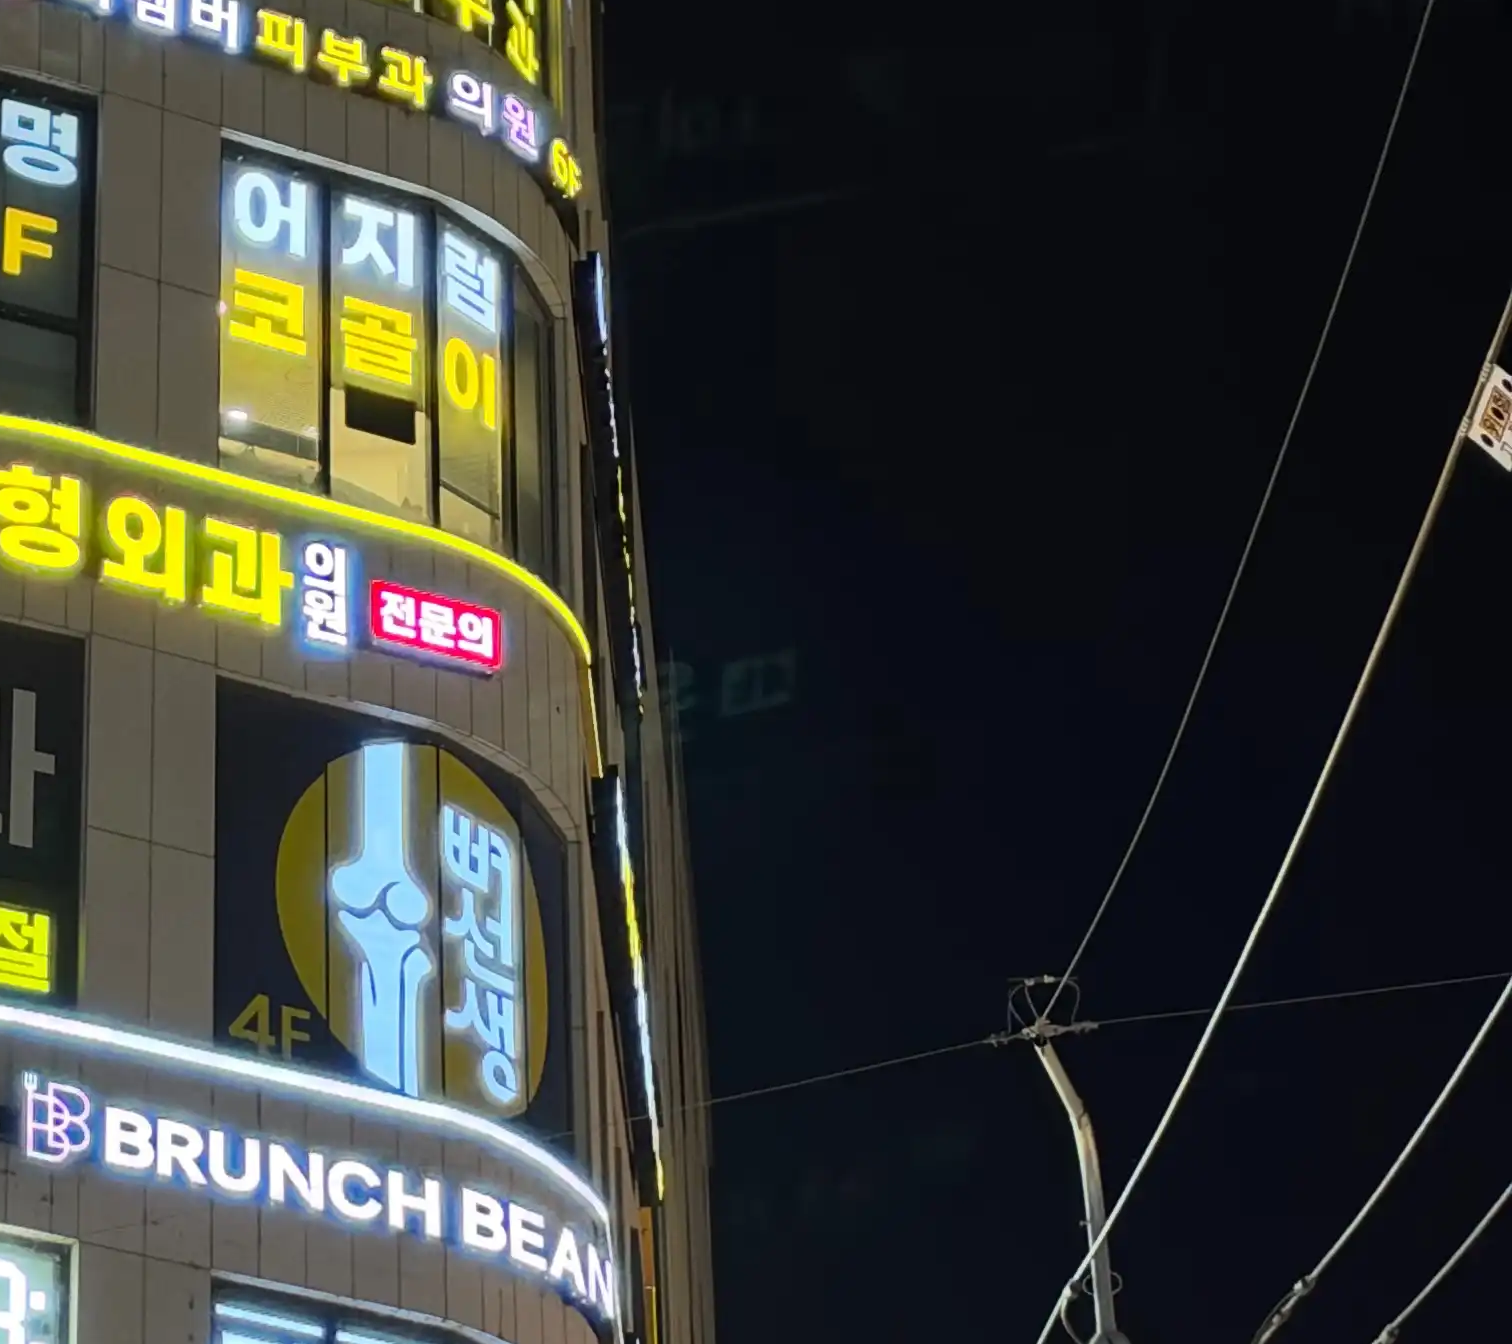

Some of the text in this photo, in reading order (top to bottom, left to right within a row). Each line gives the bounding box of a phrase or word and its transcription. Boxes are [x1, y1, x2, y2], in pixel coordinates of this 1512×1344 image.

[233, 171, 498, 332] 어지럼
[230, 269, 496, 430] 코골이
[379, 590, 494, 659] 전문의
[229, 993, 312, 1056] 4F
[103, 1105, 443, 1242] BRUNCH
[460, 1186, 617, 1321] BEAN
